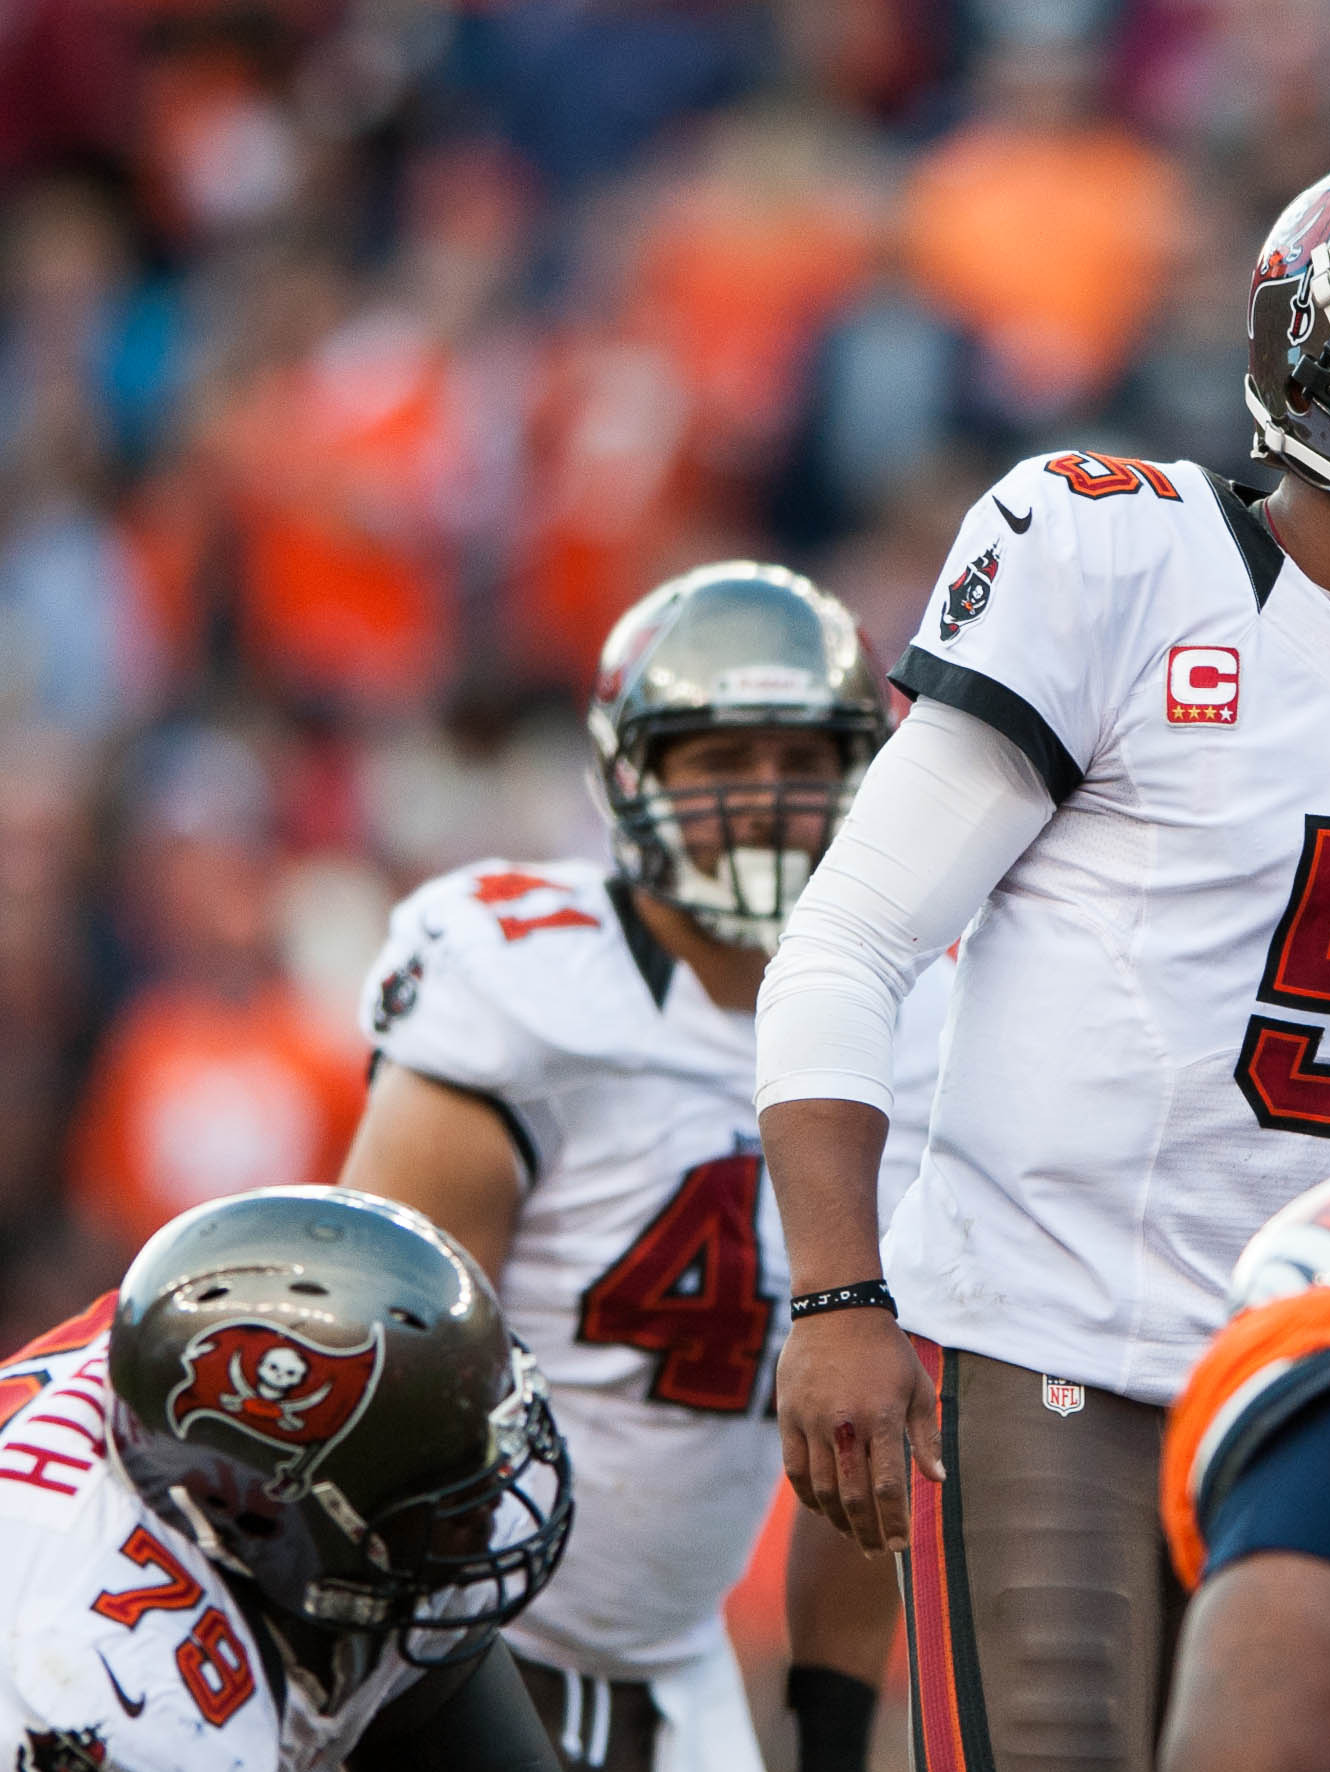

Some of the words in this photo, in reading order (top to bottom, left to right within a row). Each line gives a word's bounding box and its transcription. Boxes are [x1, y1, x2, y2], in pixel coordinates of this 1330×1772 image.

[1044, 450, 1184, 503] 5
[1169, 649, 1238, 705] C
[574, 1152, 781, 1415] 4
[1049, 1385, 1079, 1408] NFL
